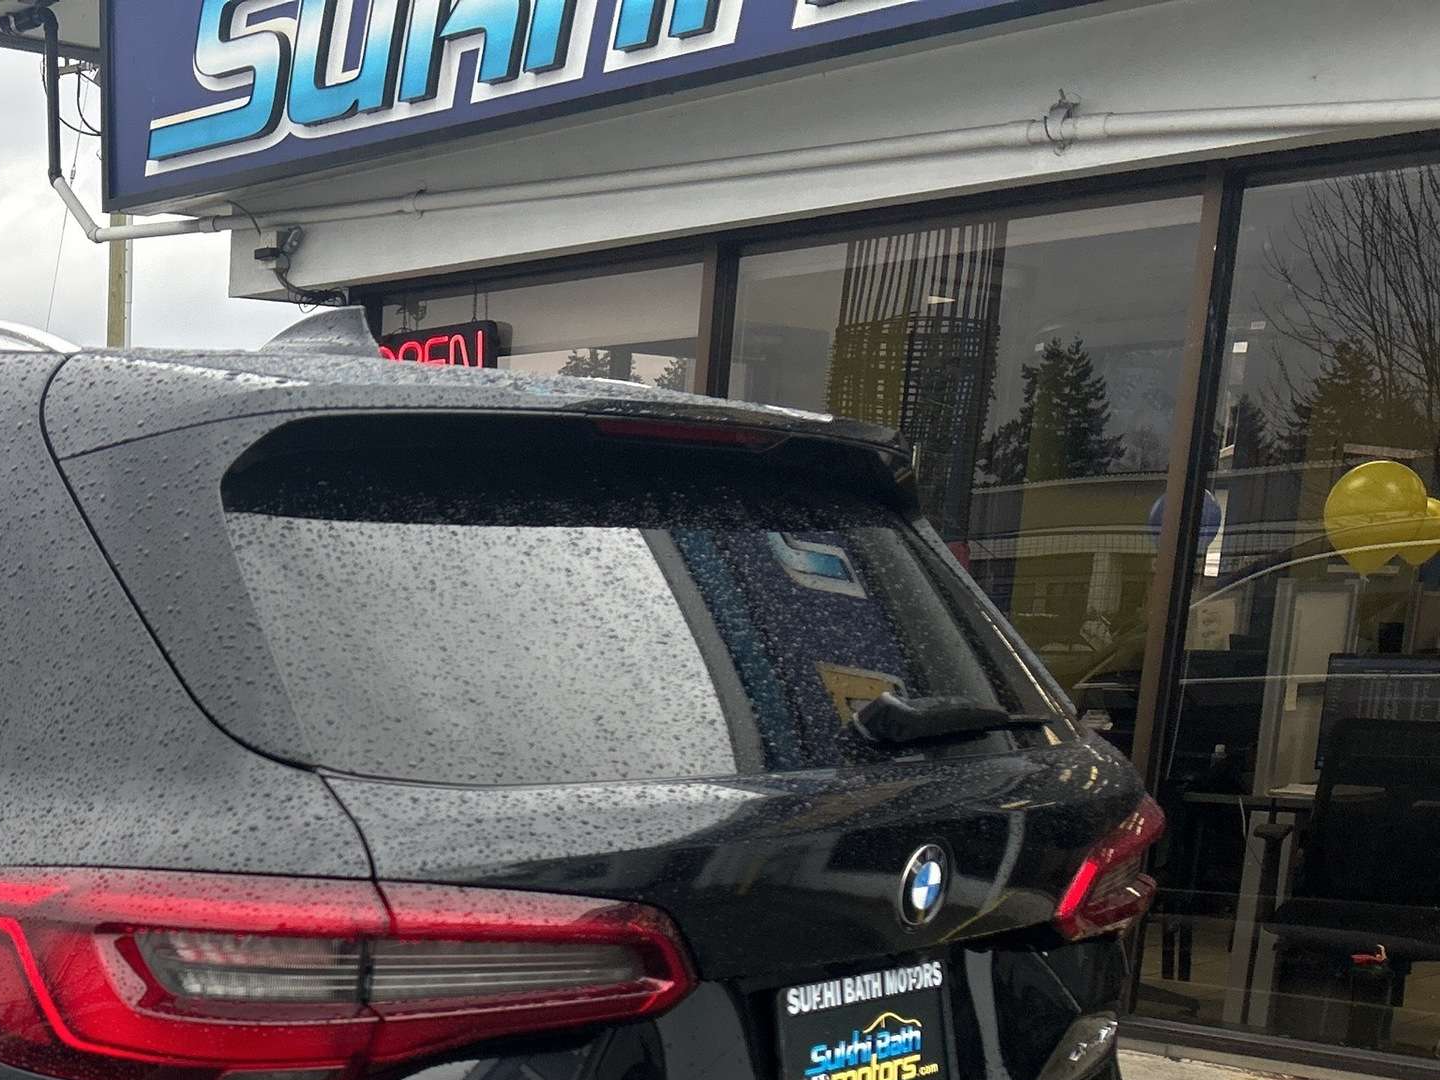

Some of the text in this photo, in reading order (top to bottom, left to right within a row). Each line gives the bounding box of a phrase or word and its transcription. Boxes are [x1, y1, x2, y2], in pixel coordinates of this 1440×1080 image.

[379, 330, 483, 368] PEN
[842, 971, 883, 1004] BATH
[803, 1026, 922, 1076] Sukhi Bath
